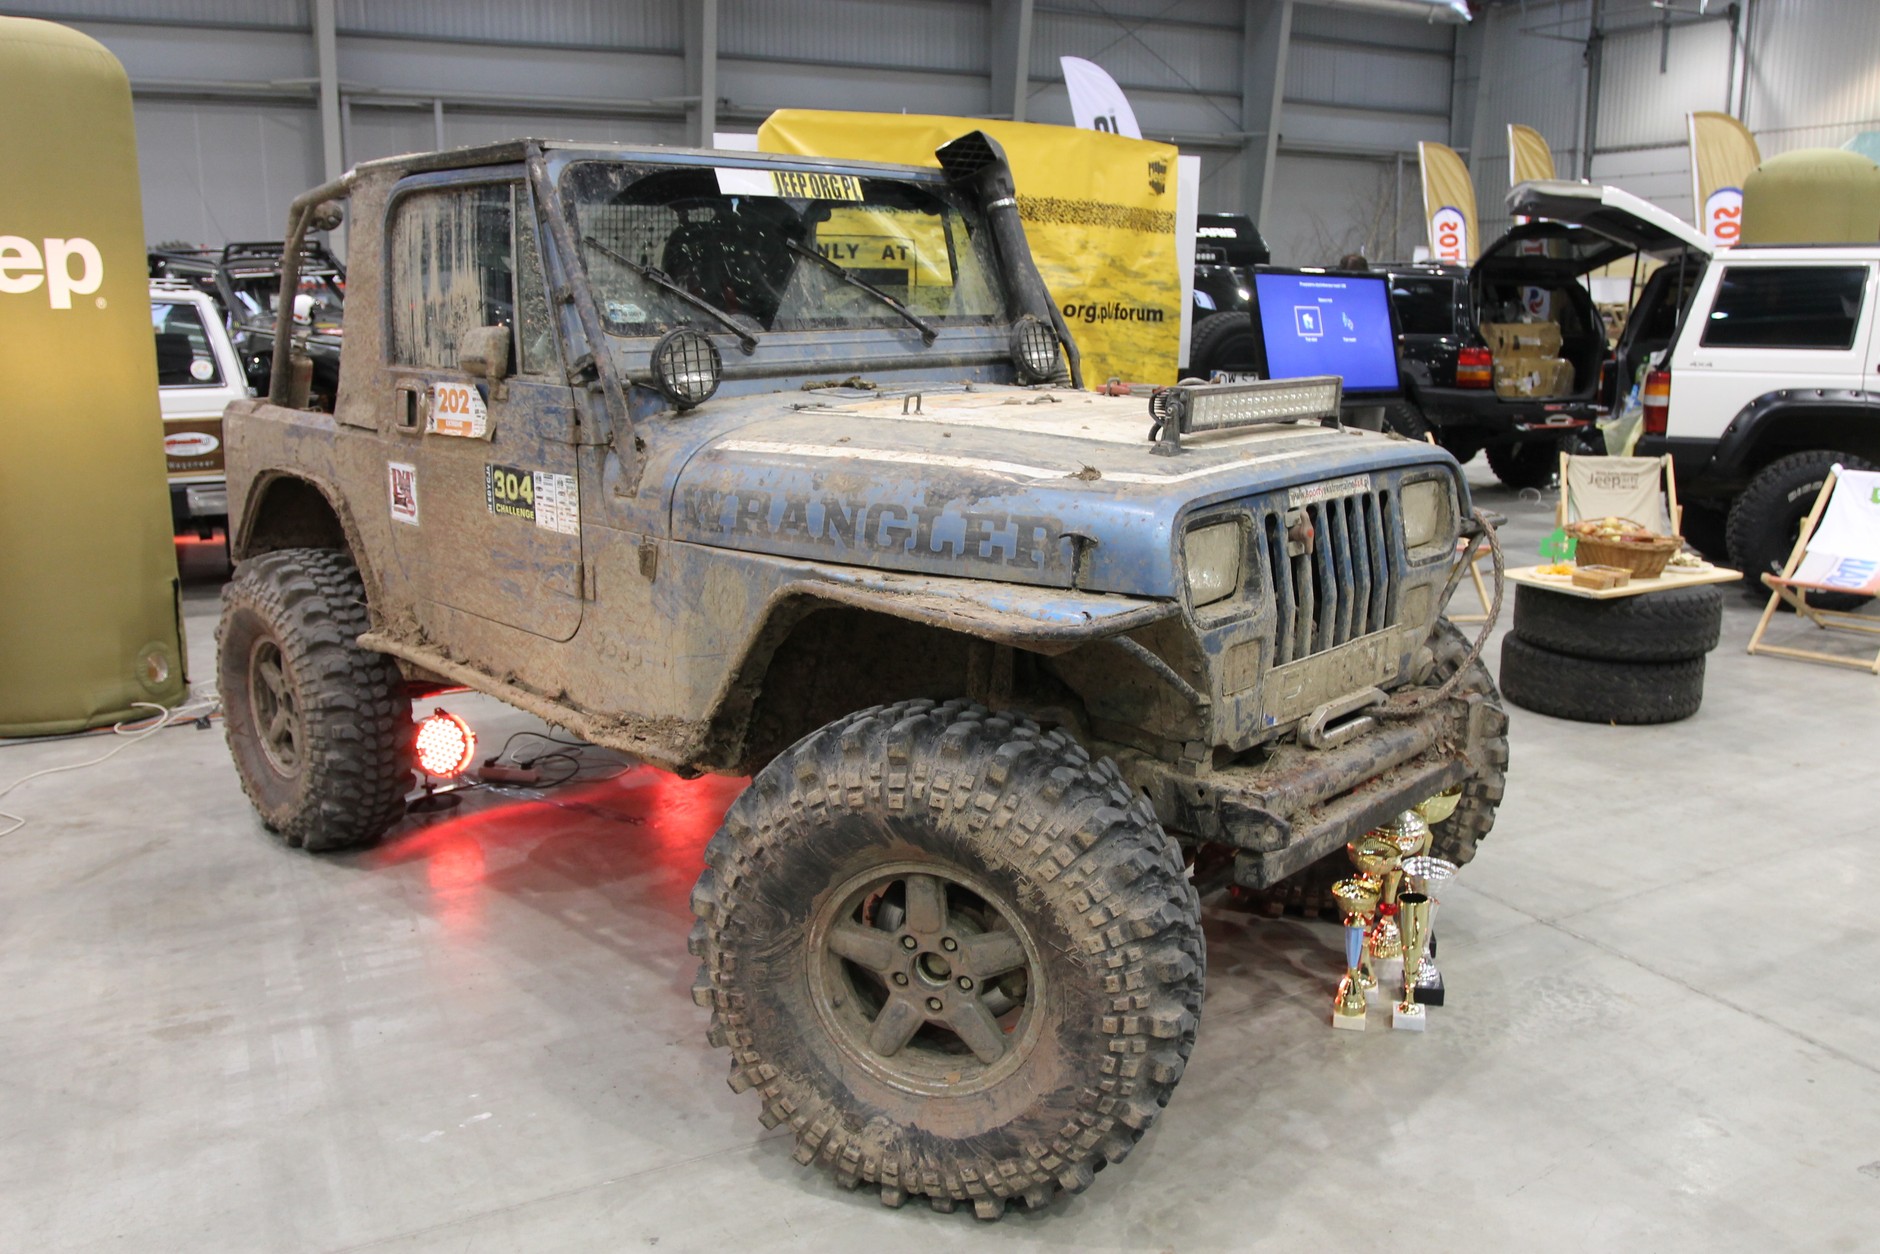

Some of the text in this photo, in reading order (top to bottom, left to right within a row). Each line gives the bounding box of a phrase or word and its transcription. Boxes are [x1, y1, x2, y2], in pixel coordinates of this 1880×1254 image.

[882, 245, 909, 261] AT
[437, 387, 470, 415] 202
[493, 470, 534, 505] 304
[496, 503, 535, 520] CHALLENGE
[682, 489, 1067, 570] WRANGLER
